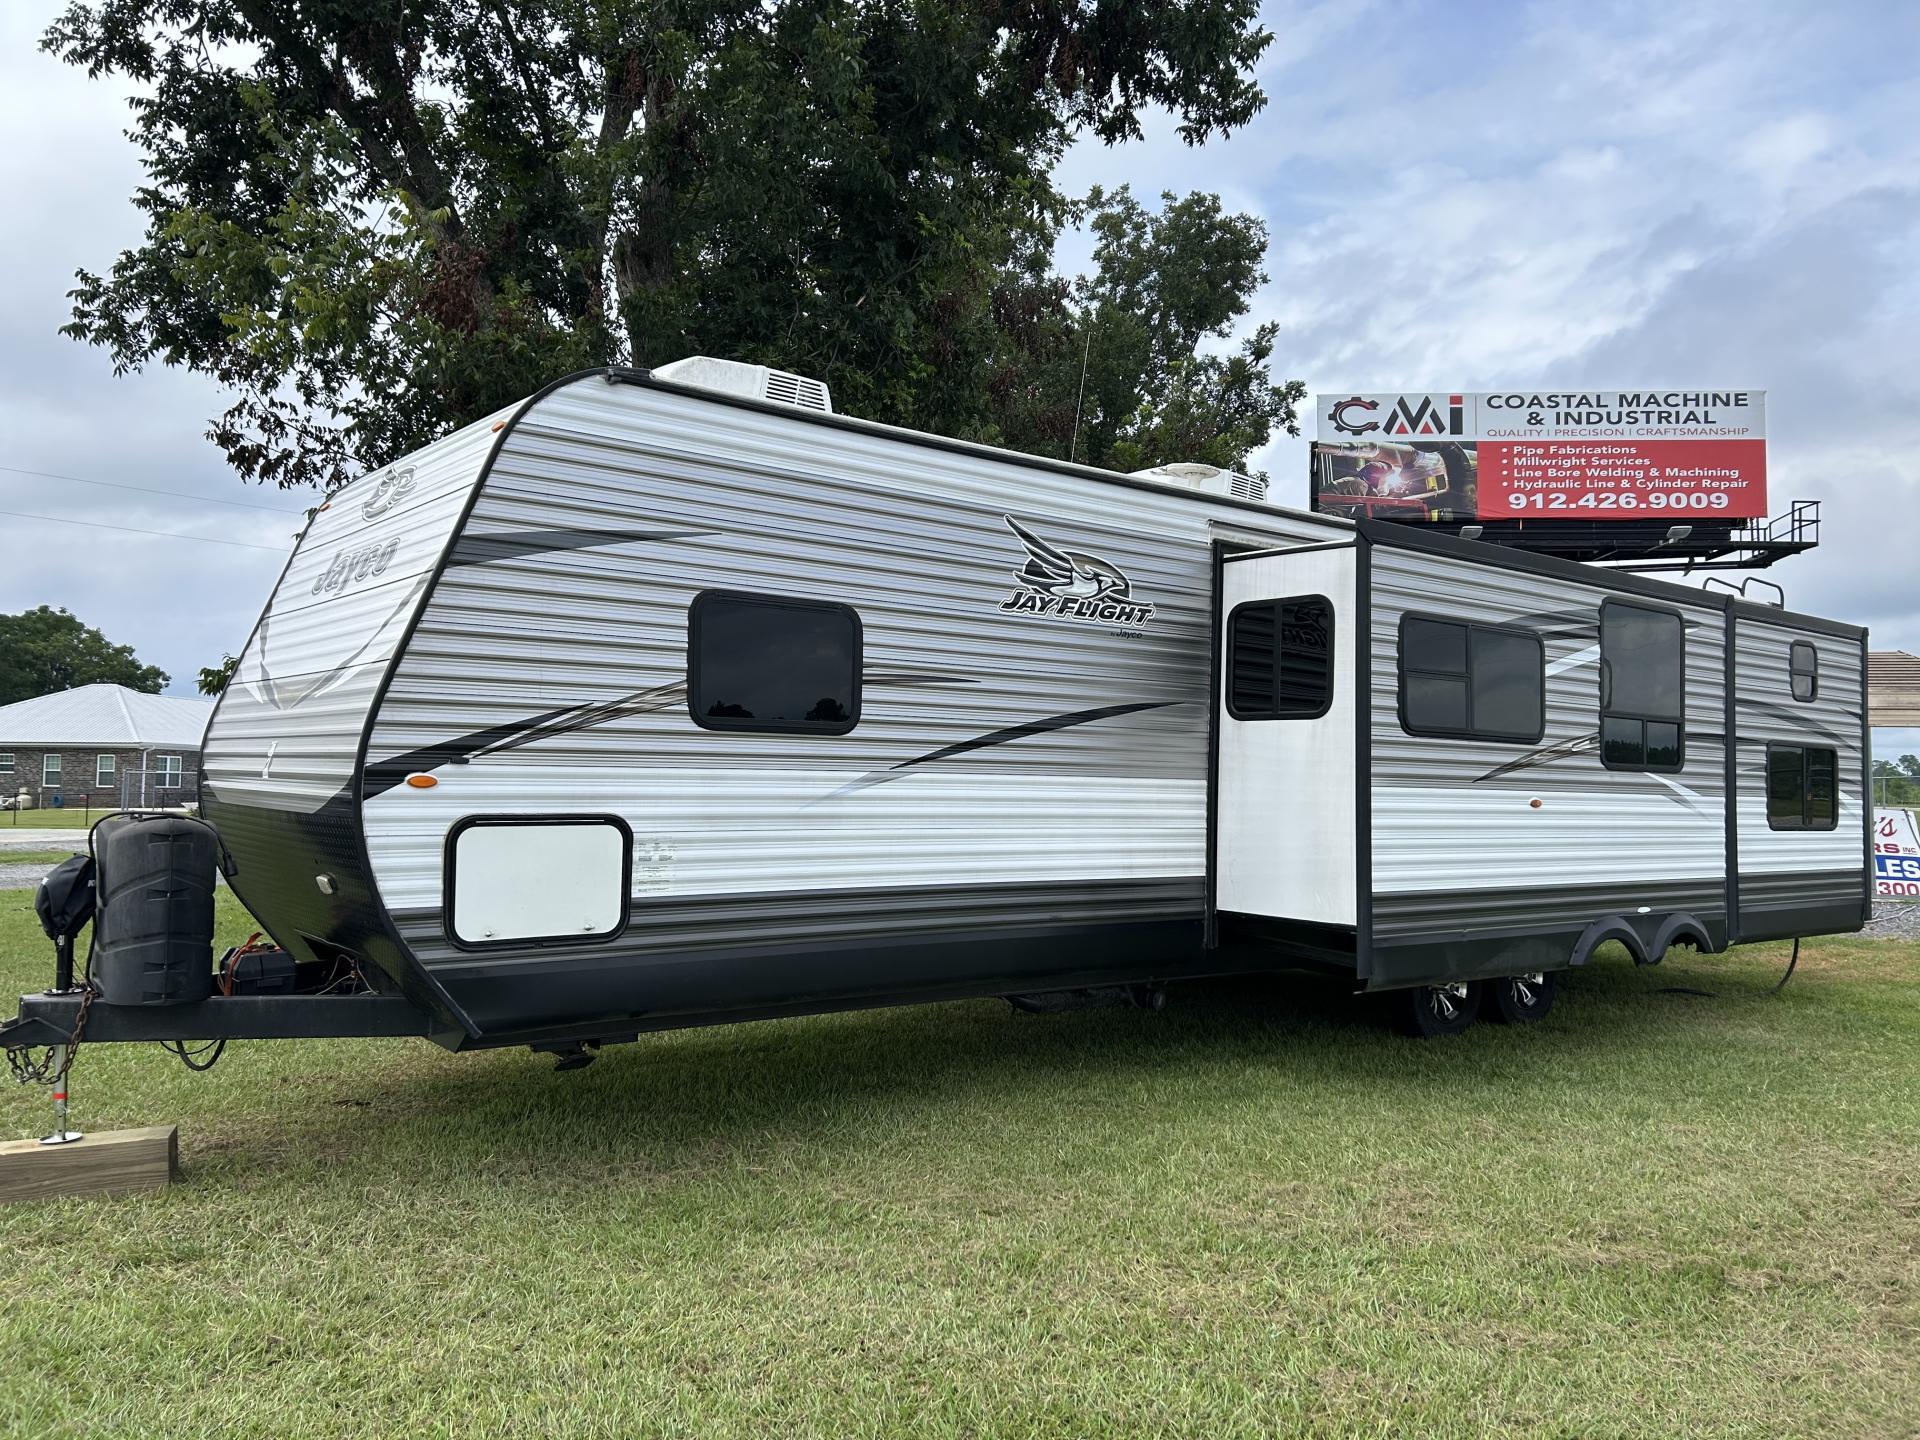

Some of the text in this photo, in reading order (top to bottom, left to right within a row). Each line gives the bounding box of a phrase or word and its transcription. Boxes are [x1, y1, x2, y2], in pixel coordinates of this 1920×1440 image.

[1486, 392, 1749, 410] COASTAL MACHINE
[1526, 409, 1717, 426] & INDUSTRIAL
[1487, 427, 1749, 438] QUALITY PRECISION CRAFTSMANSHIP
[1513, 445, 1637, 455] Pipe Fabrications
[1513, 456, 1652, 467] Millwright Services
[1513, 468, 1740, 479] Line Bore Welding & Machining
[1513, 479, 1749, 490] Hydraulic Line & Cylinder Repair
[1508, 492, 1730, 509] 912.426.9009
[999, 590, 1155, 625] JAY FLIGHT
[1117, 628, 1143, 640] Jayco
